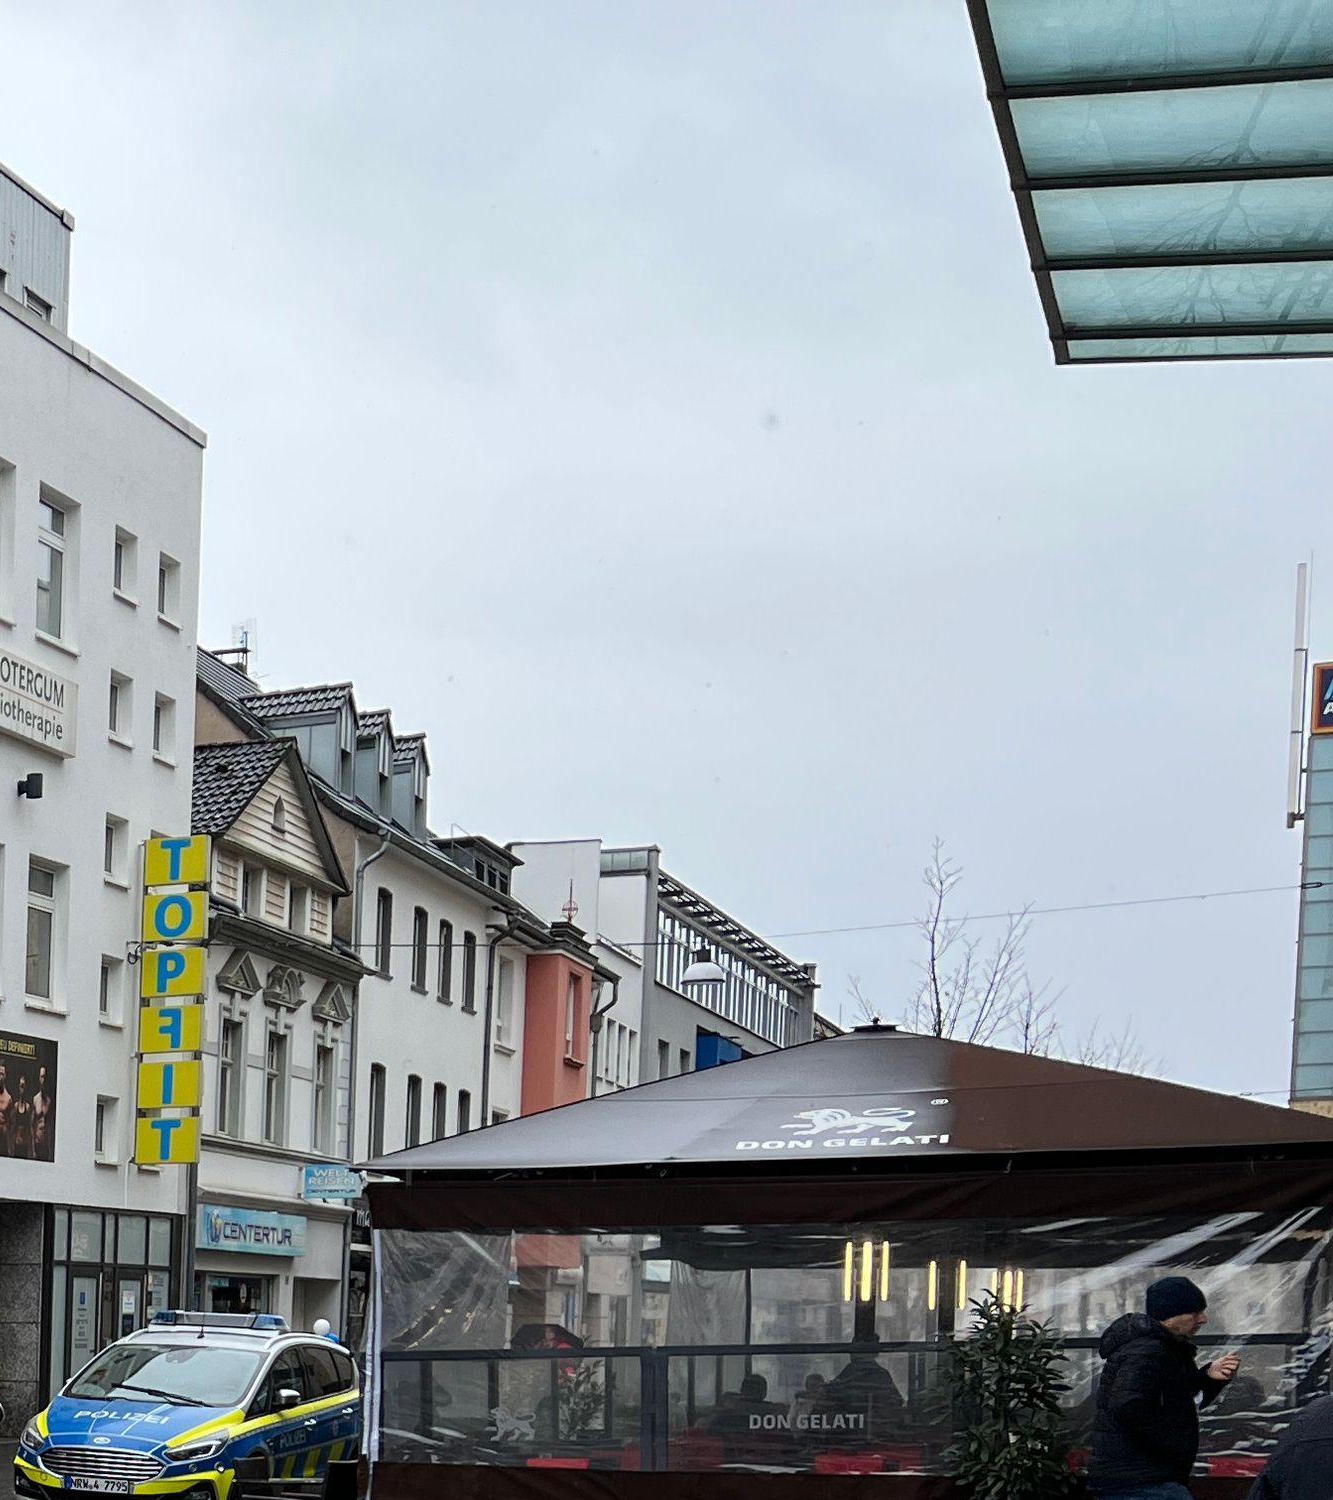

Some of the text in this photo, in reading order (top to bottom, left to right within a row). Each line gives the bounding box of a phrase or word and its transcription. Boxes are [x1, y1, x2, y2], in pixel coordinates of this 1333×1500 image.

[735, 1134, 950, 1150] DON GELATI
[307, 1176, 355, 1186] REISEN
[223, 1221, 293, 1247] CENTERTUR
[74, 1410, 170, 1425] POLIZEI
[749, 1413, 864, 1429] DON GELATI
[71, 1476, 89, 1488] NRW
[104, 1480, 128, 1492] 7795
